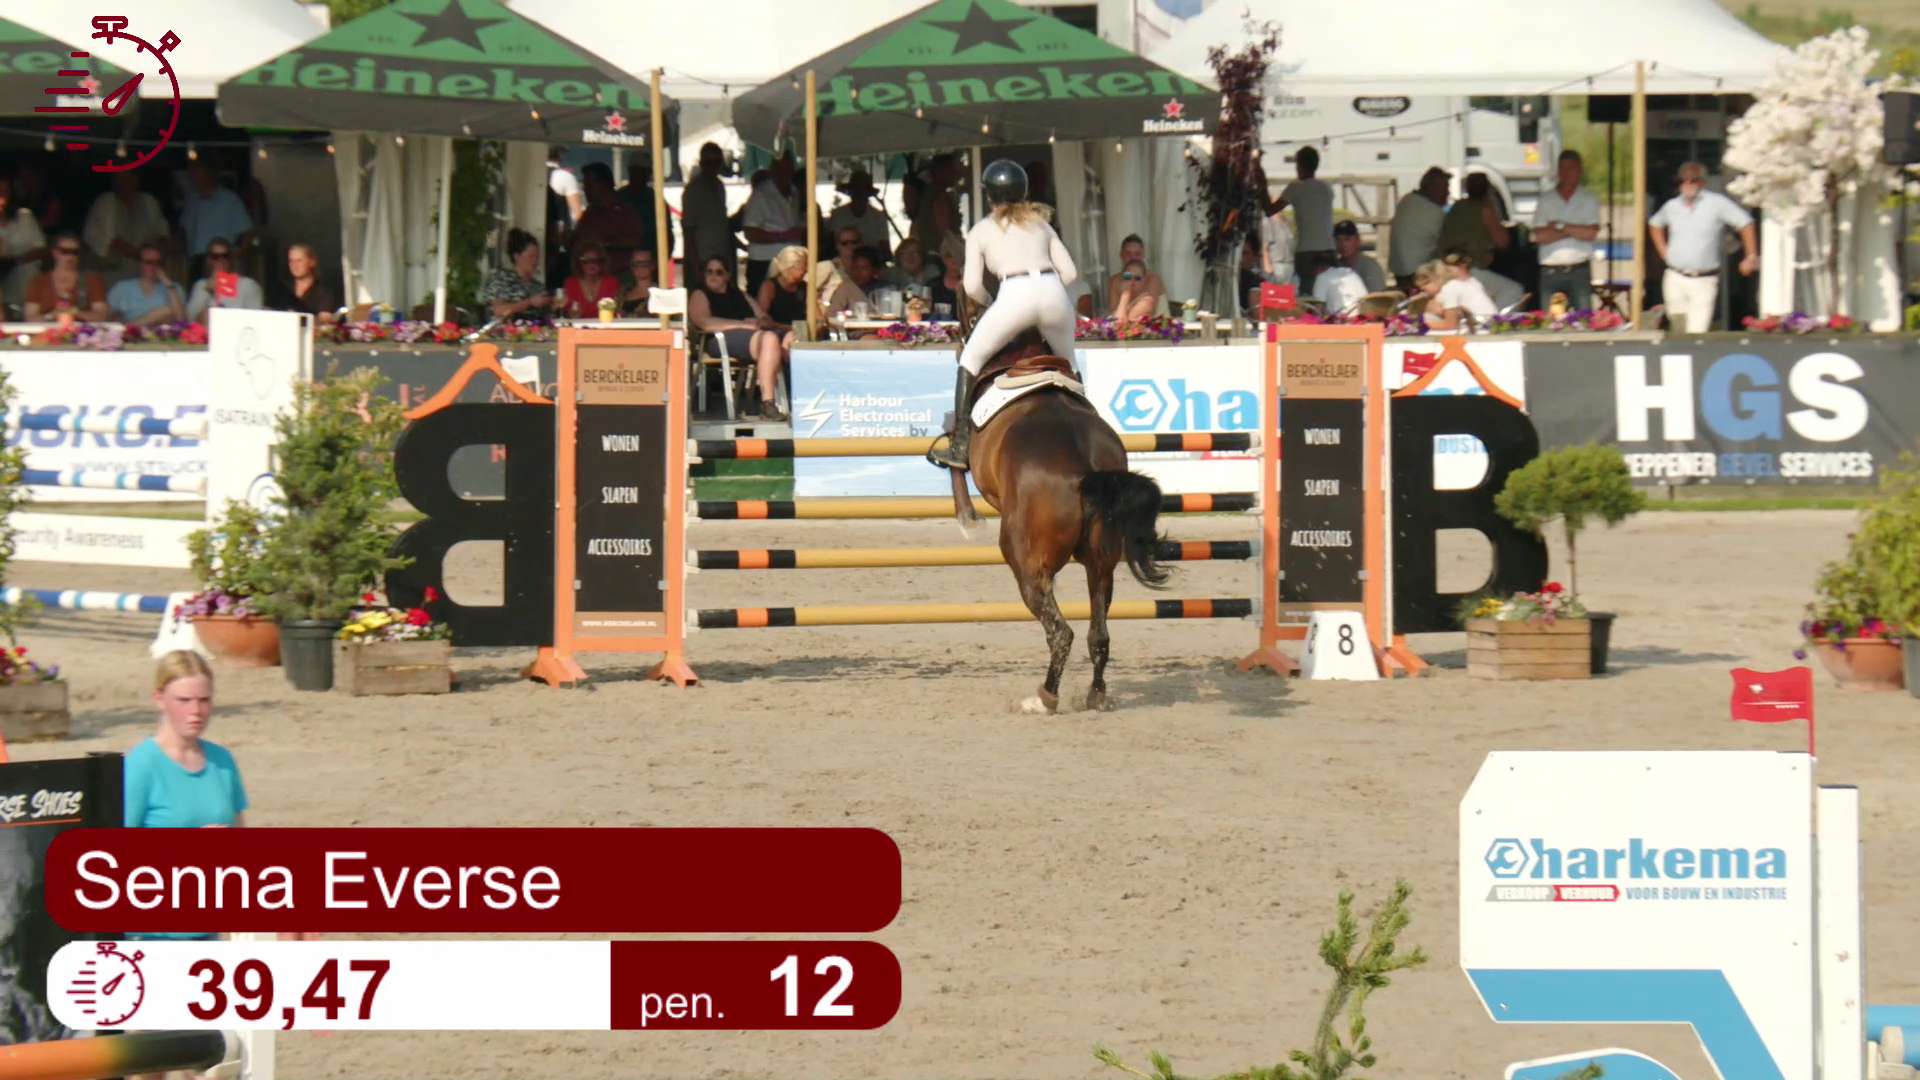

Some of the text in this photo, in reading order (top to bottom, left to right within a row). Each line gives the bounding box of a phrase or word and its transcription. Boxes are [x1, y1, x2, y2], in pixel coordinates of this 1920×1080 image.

[236, 51, 652, 110] Heineken
[802, 66, 1206, 118] Heineken
[1143, 118, 1205, 133] Heineken
[583, 129, 645, 147] Heineken
[583, 368, 660, 385] BERCKELAER
[1286, 363, 1360, 379] BERCKELAER
[839, 393, 905, 407] Harbour
[1614, 352, 1869, 442] HGS
[839, 408, 933, 423] Electronical
[841, 423, 906, 438] Services
[1304, 427, 1341, 445] WONEN
[602, 434, 640, 452] WONEN
[1719, 452, 1778, 477] GEVEL
[1779, 451, 1874, 478] SERVICES
[602, 486, 639, 504] SLAPEN
[1304, 479, 1340, 496] SLAPEN
[1290, 529, 1353, 547] ACCESSOIRES
[587, 539, 652, 556] ACCESSOIRES
[1338, 623, 1355, 656] 8
[30, 788, 84, 818] SHOES
[1529, 838, 1788, 880] harkema
[1625, 886, 1660, 901] VOOR
[1663, 886, 1701, 901] BOUW
[1704, 886, 1719, 901] EN
[1722, 886, 1788, 901] INDUSTRIE
